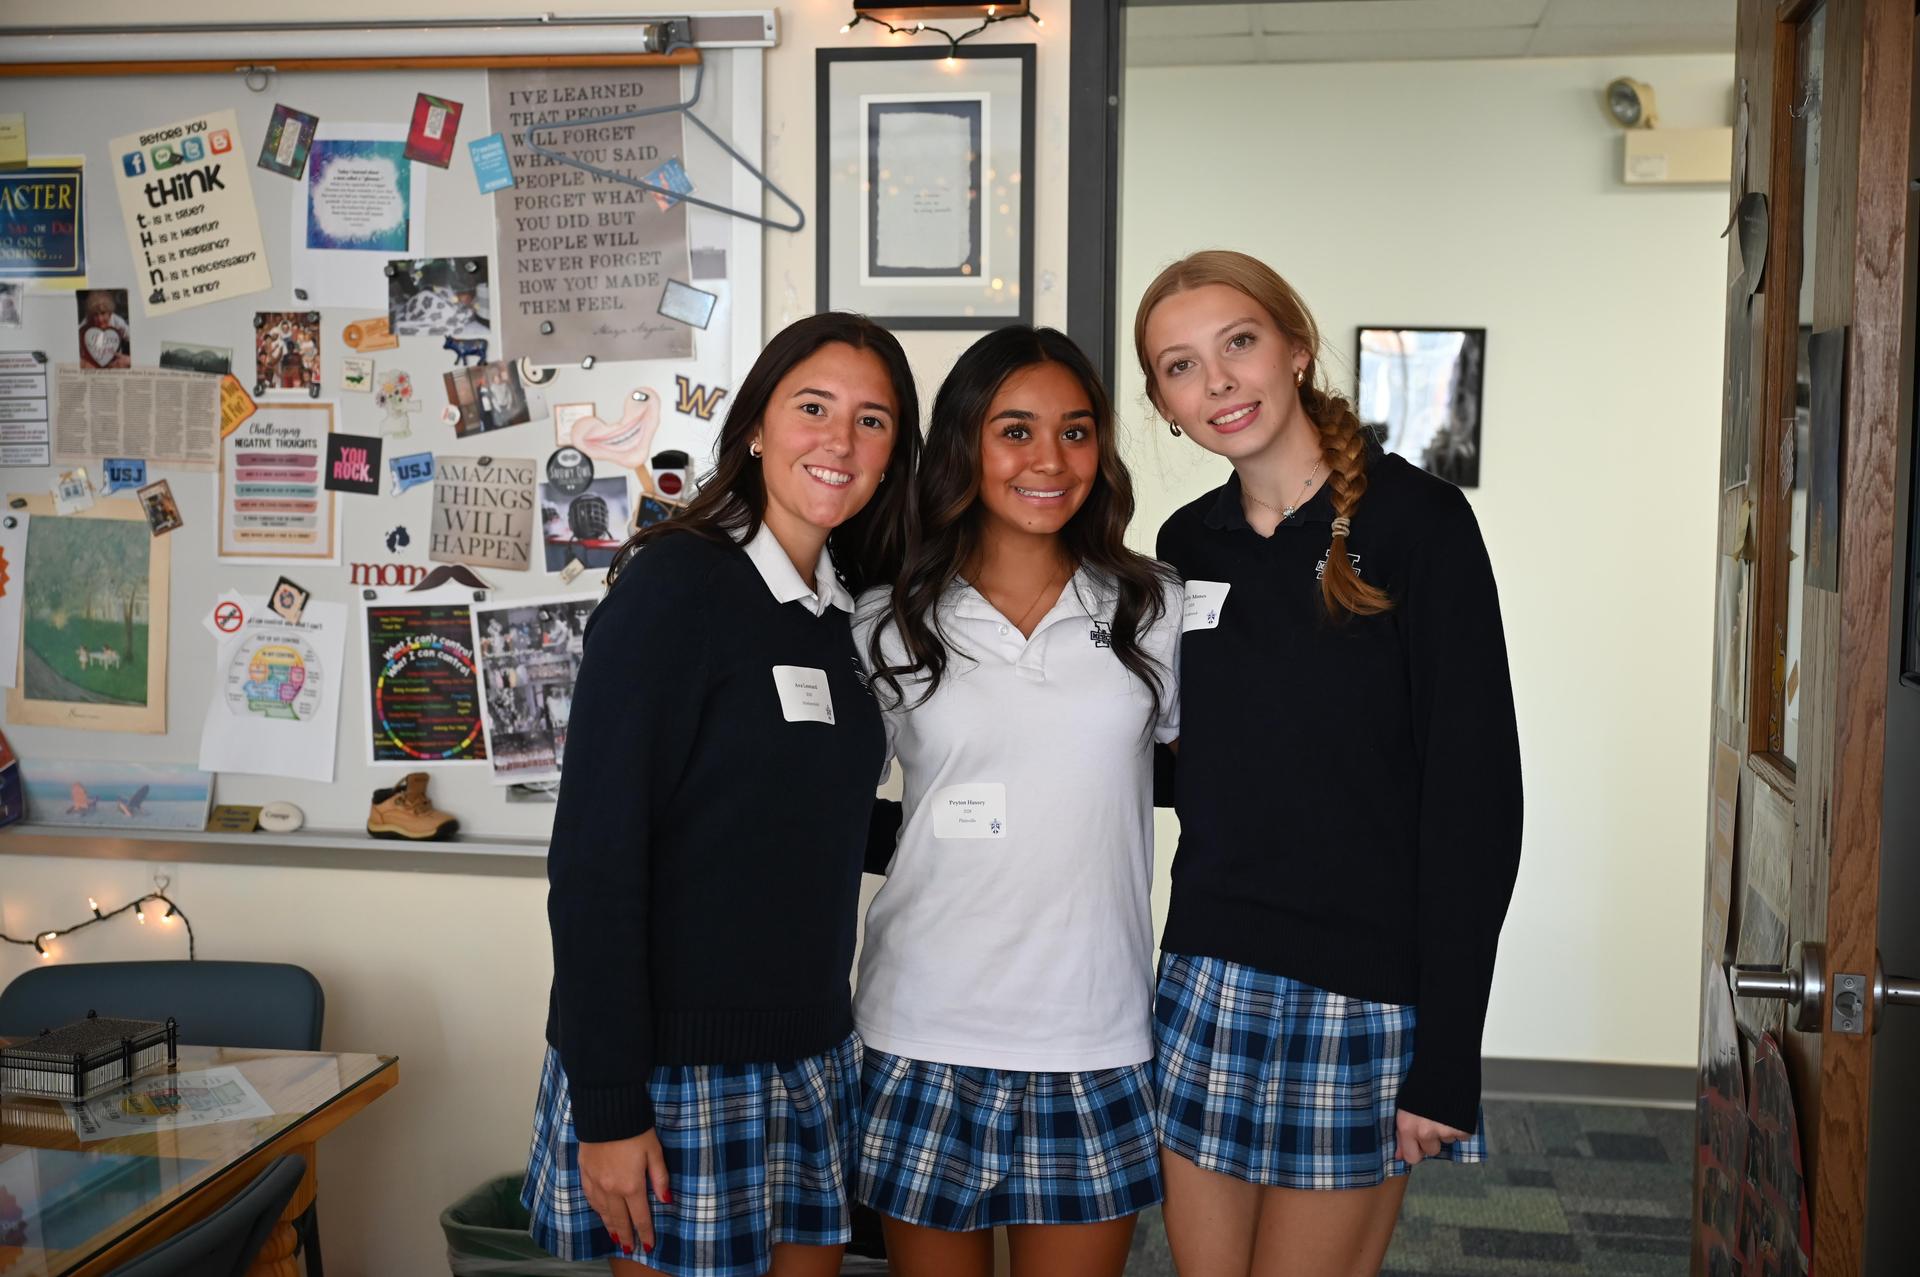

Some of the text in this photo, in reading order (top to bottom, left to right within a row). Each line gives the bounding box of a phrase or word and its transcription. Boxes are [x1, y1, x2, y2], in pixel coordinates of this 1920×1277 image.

[553, 82, 644, 102] LEARNED
[510, 110, 559, 127] THAT
[563, 126, 636, 144] FORGET
[573, 149, 607, 163] YOU
[514, 171, 585, 190] PEOPLE
[0, 184, 72, 209] ACTER
[514, 189, 648, 210] FORGET WHAT
[516, 216, 550, 232] YOU
[598, 211, 636, 226] BUT
[517, 232, 639, 252] PEOPLE WILL
[517, 251, 662, 273] NEVER FORGET
[519, 272, 660, 294] HOW YOU MADE
[519, 299, 571, 315] THEM
[676, 374, 728, 421] W
[249, 423, 301, 437] Challenging
[235, 438, 317, 448] NEGATIVE THOUGHTS
[340, 447, 367, 464] YOU
[110, 468, 142, 482] USJ
[333, 460, 373, 482] ROCK.
[398, 462, 432, 480] USJ
[436, 465, 533, 485] AMAZING
[435, 484, 533, 510] THINGS
[444, 508, 521, 538] WILL
[433, 534, 529, 562] HAPPEN
[350, 563, 427, 586] mom
[382, 640, 405, 660] What
[414, 632, 438, 643] can't
[439, 637, 473, 658] control
[387, 649, 471, 678] What I can control
